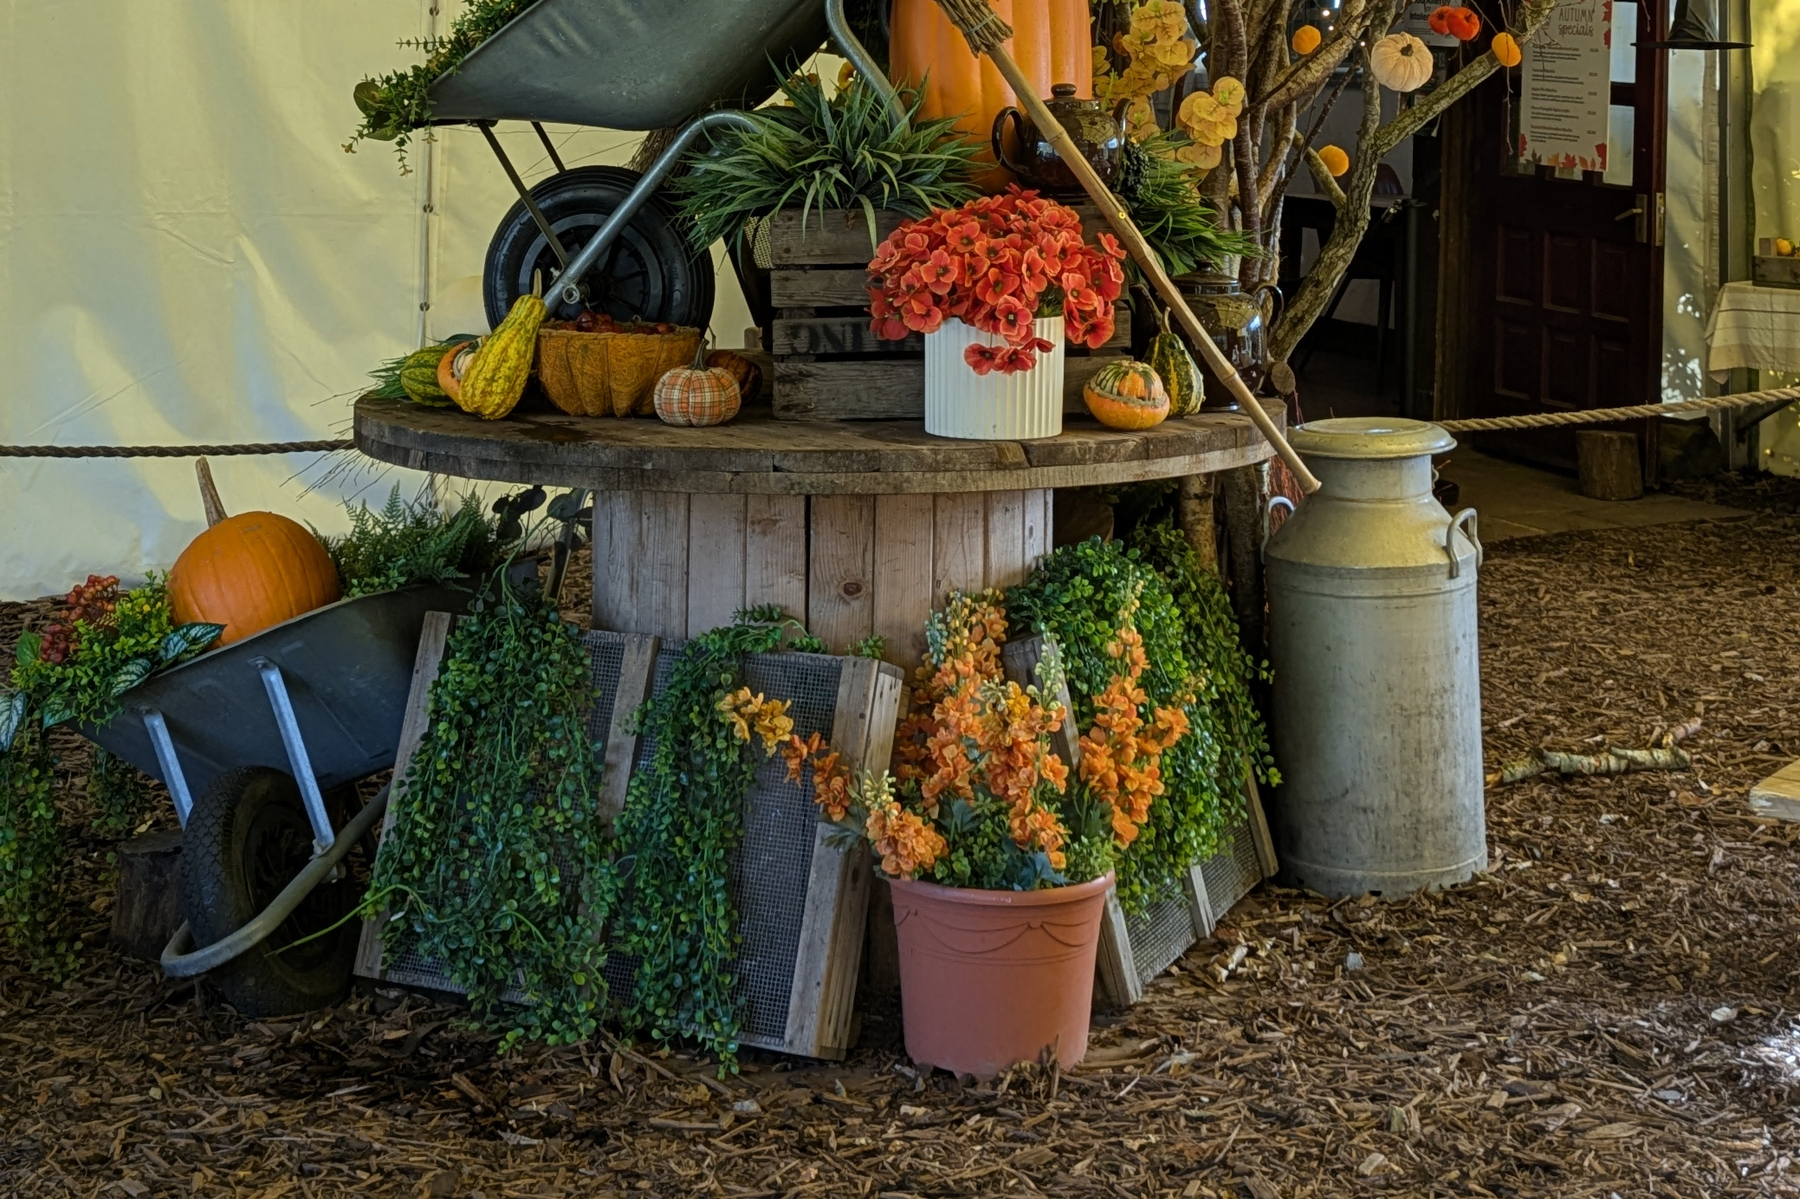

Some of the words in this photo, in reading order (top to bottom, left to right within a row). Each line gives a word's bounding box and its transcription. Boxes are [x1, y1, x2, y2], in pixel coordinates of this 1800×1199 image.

[1409, 12, 1430, 21] Intoler
[1558, 8, 1593, 23] AUTUMN
[1558, 23, 1594, 38] specials
